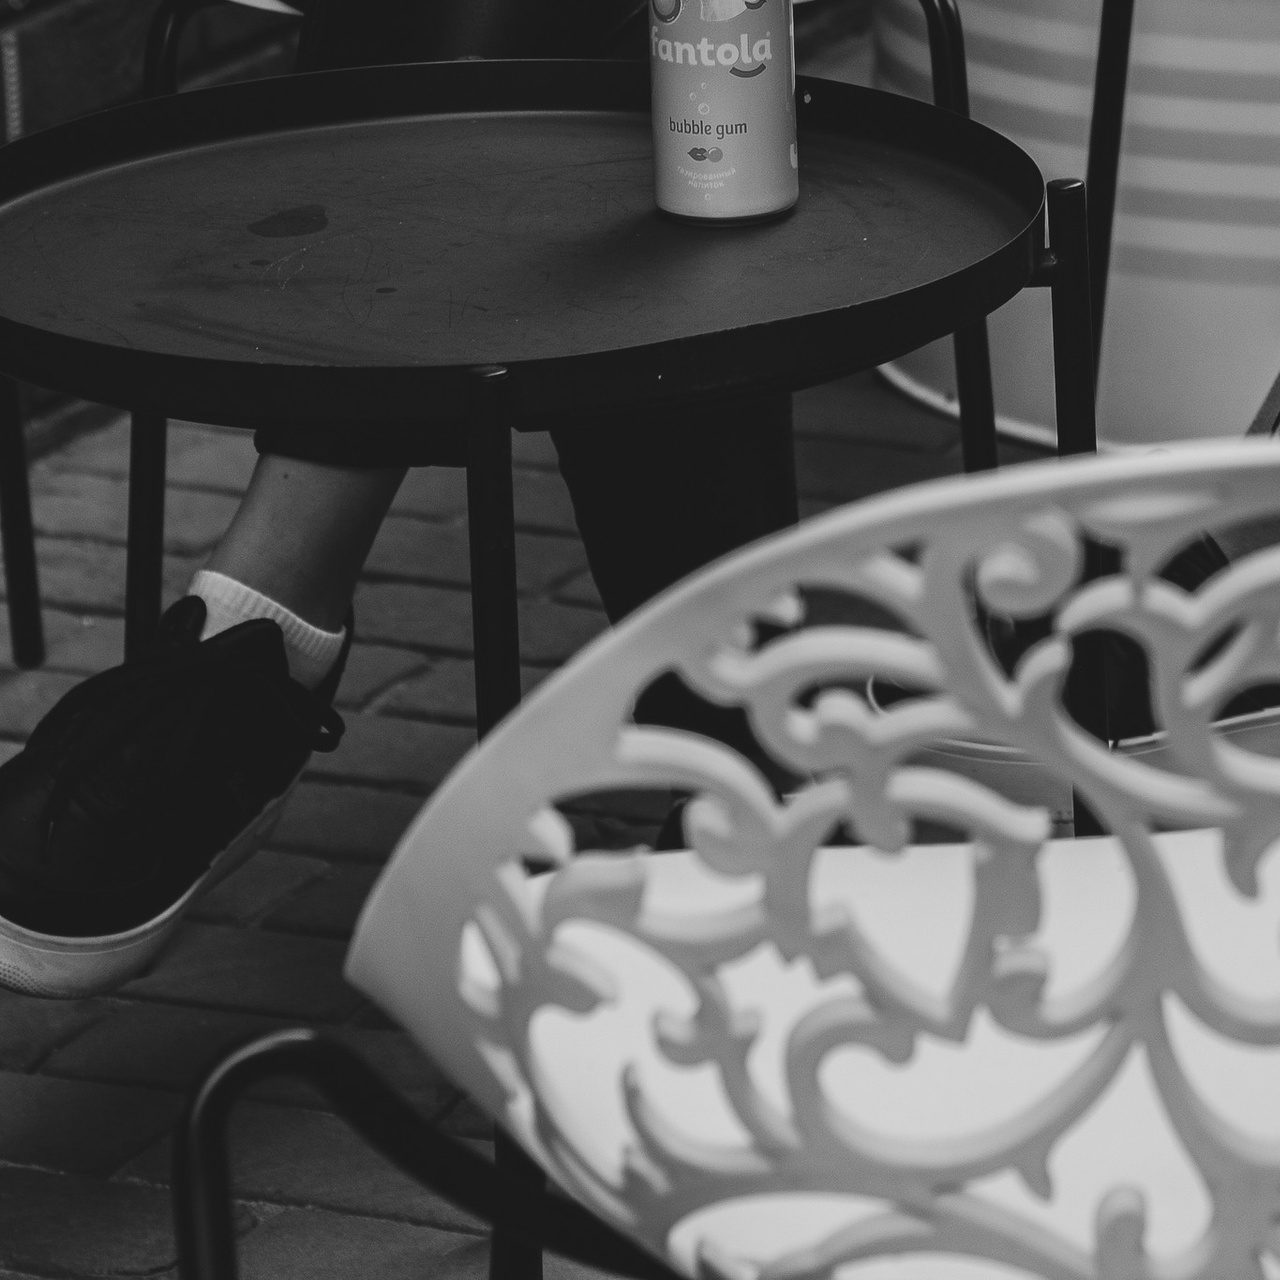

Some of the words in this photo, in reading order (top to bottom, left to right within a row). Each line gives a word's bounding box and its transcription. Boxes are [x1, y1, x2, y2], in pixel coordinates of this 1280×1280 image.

[652, 25, 772, 66] fantola
[669, 116, 712, 136] bubble
[715, 122, 748, 140] gum
